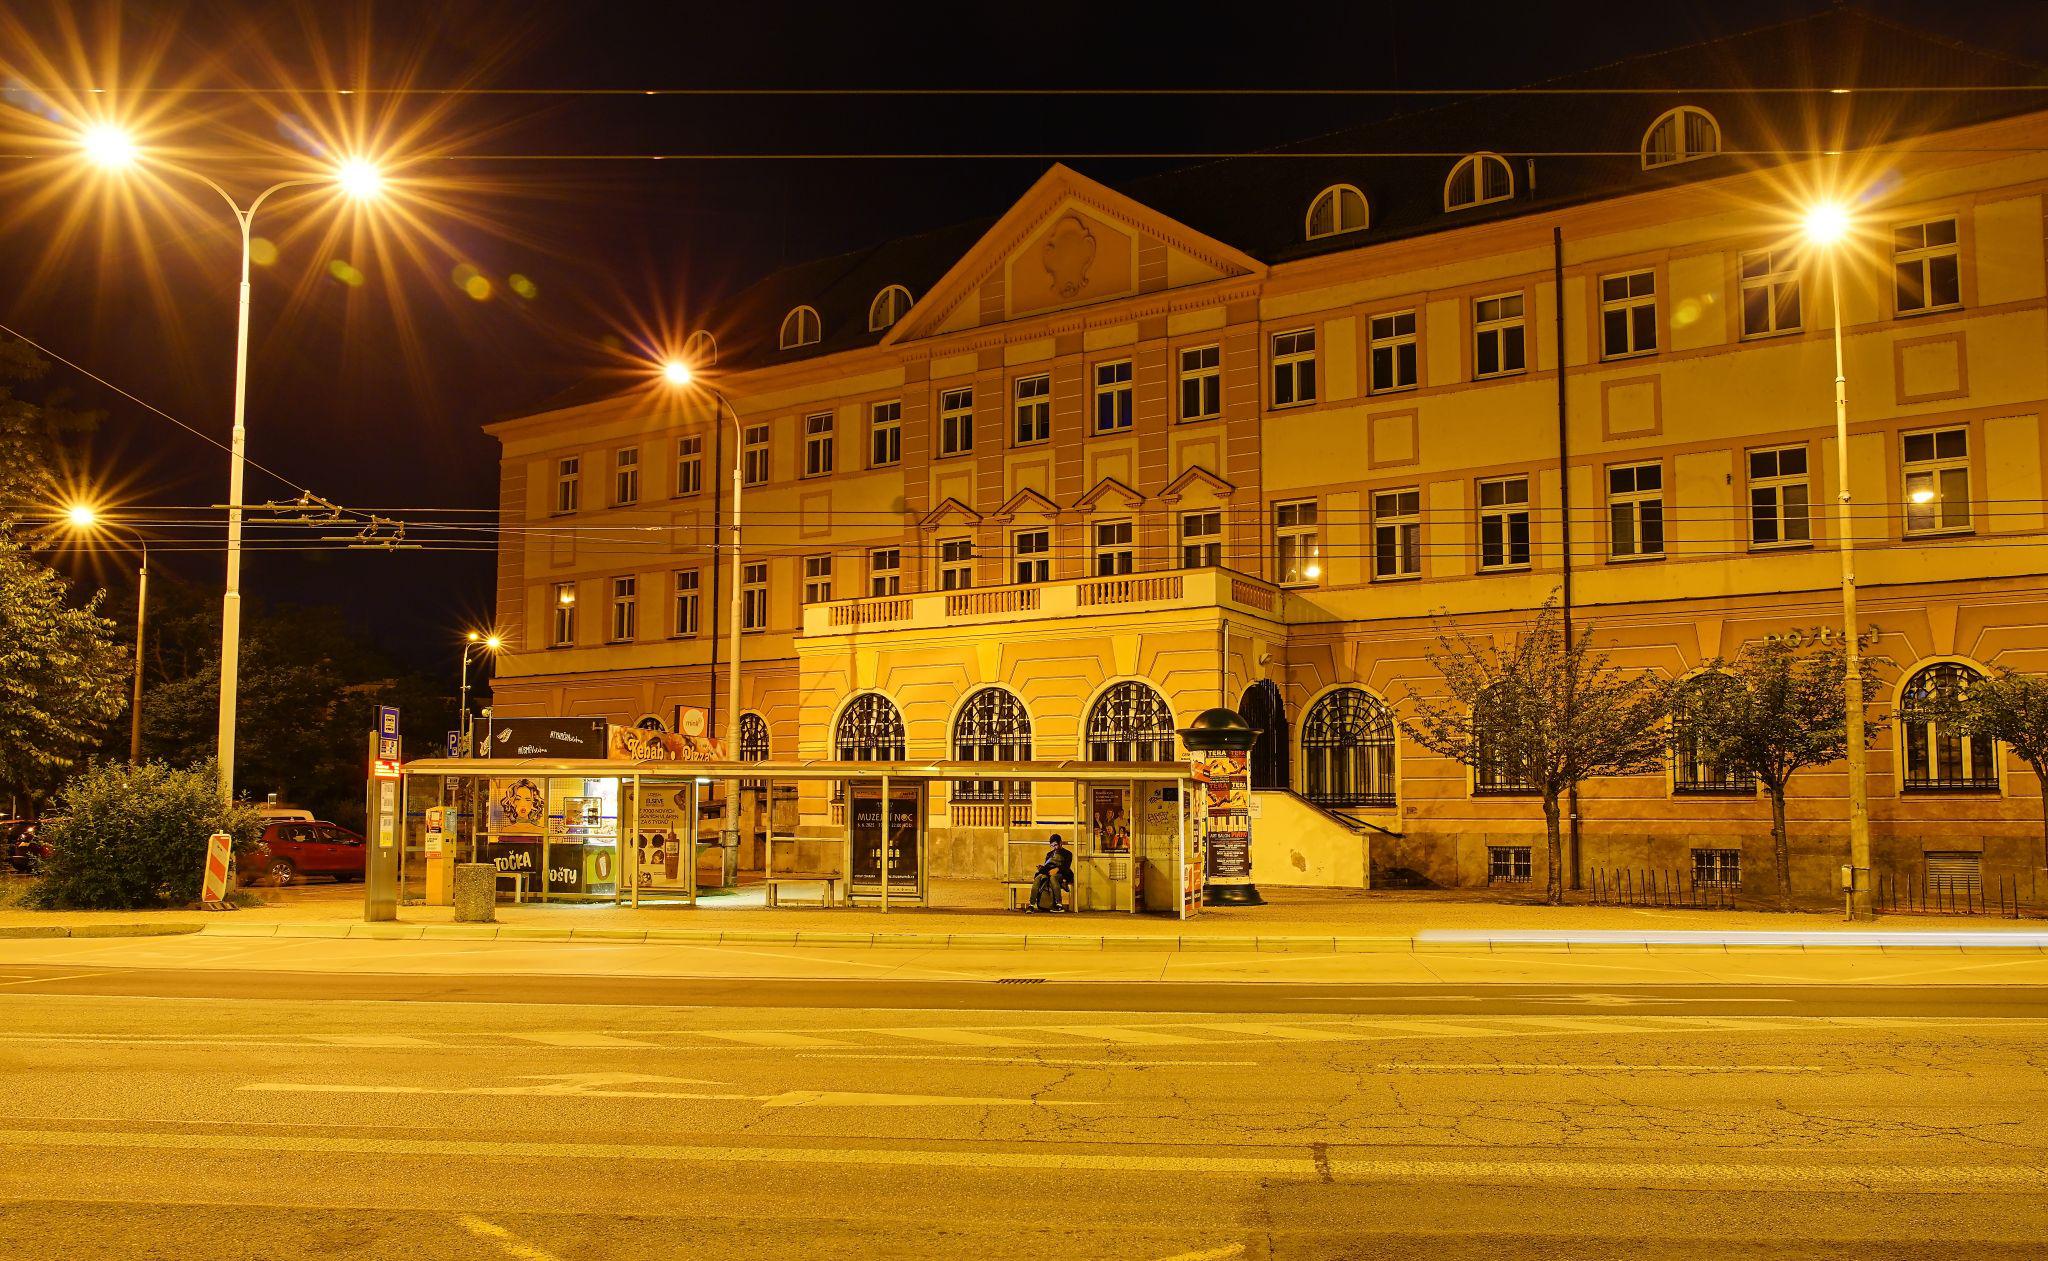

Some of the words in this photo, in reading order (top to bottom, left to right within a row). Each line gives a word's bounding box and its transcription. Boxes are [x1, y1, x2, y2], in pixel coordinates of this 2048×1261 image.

[450, 734, 457, 749] P
[628, 739, 664, 760] Kebab
[683, 745, 710, 761] Pizza
[494, 850, 532, 872] TOČKA
[548, 867, 577, 884] OŠTY
